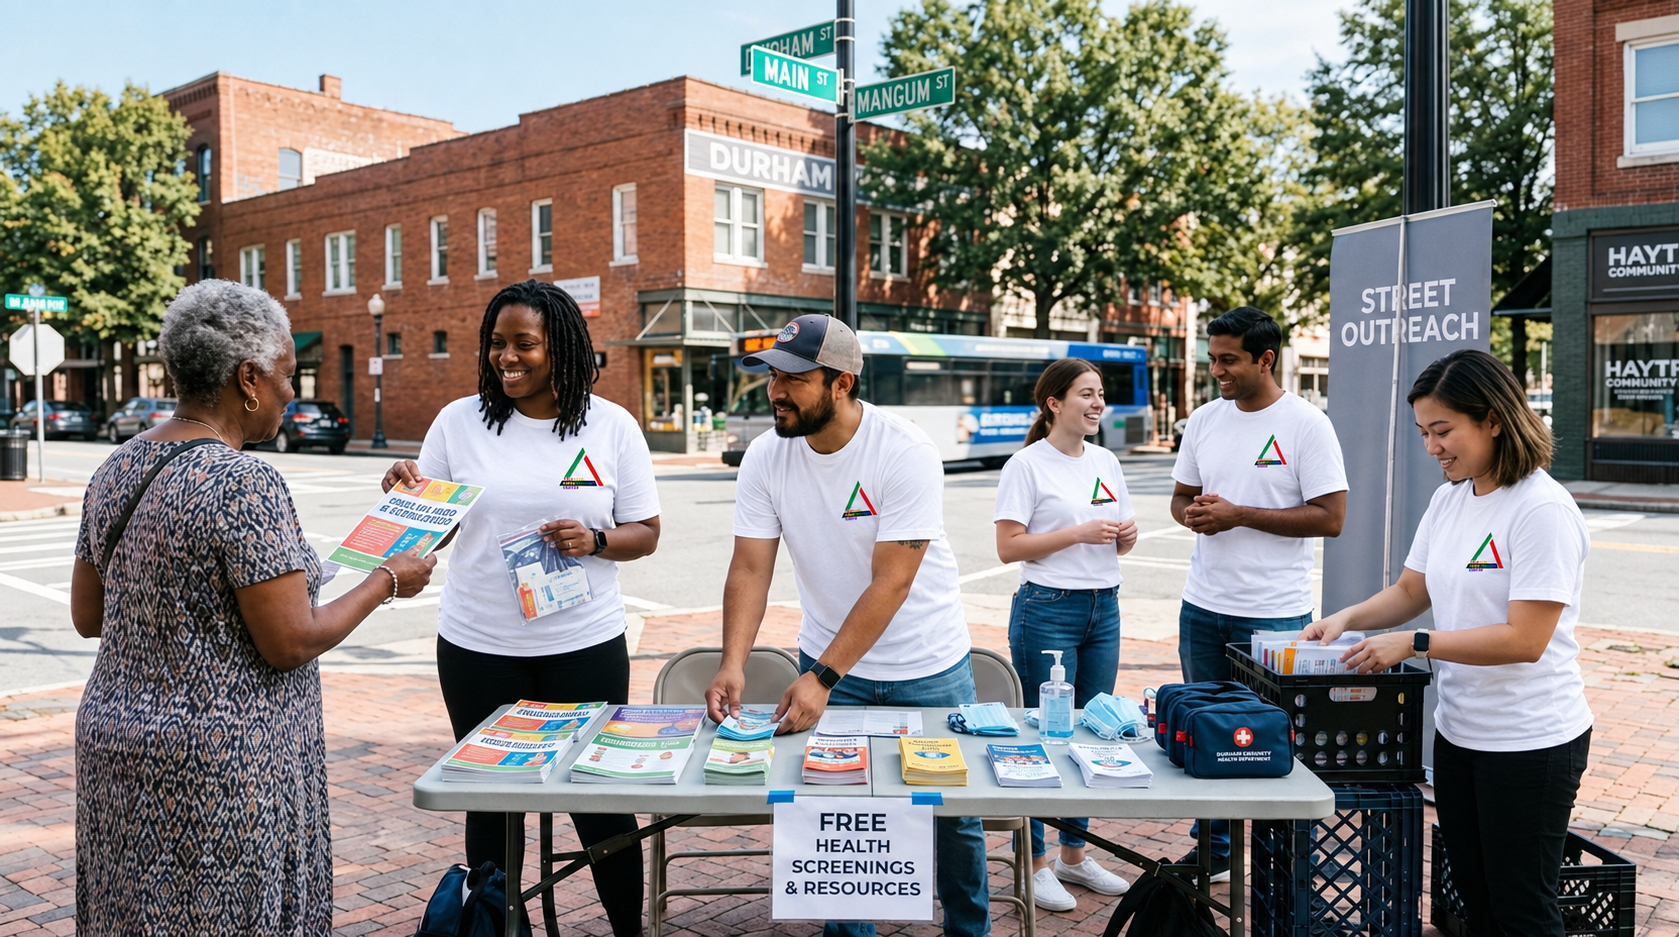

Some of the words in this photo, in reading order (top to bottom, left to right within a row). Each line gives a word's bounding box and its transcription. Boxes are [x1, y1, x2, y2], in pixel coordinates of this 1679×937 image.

[820, 26, 832, 41] ST
[764, 56, 809, 91] MAIN
[816, 71, 829, 86] ST
[857, 78, 930, 114] MANGUM
[936, 74, 949, 90] ST
[709, 141, 832, 191] DURHAM
[1608, 264, 1679, 278] COMMUNIT
[1361, 278, 1456, 314] STREET
[1341, 311, 1479, 347] OUTREACH
[1605, 378, 1678, 388] COMMUNITY
[820, 812, 887, 832] FREE
[816, 839, 891, 854] HEALTH
[792, 859, 915, 875] SCREENINGS
[785, 881, 798, 895] &
[804, 881, 921, 896] RESOURCES
